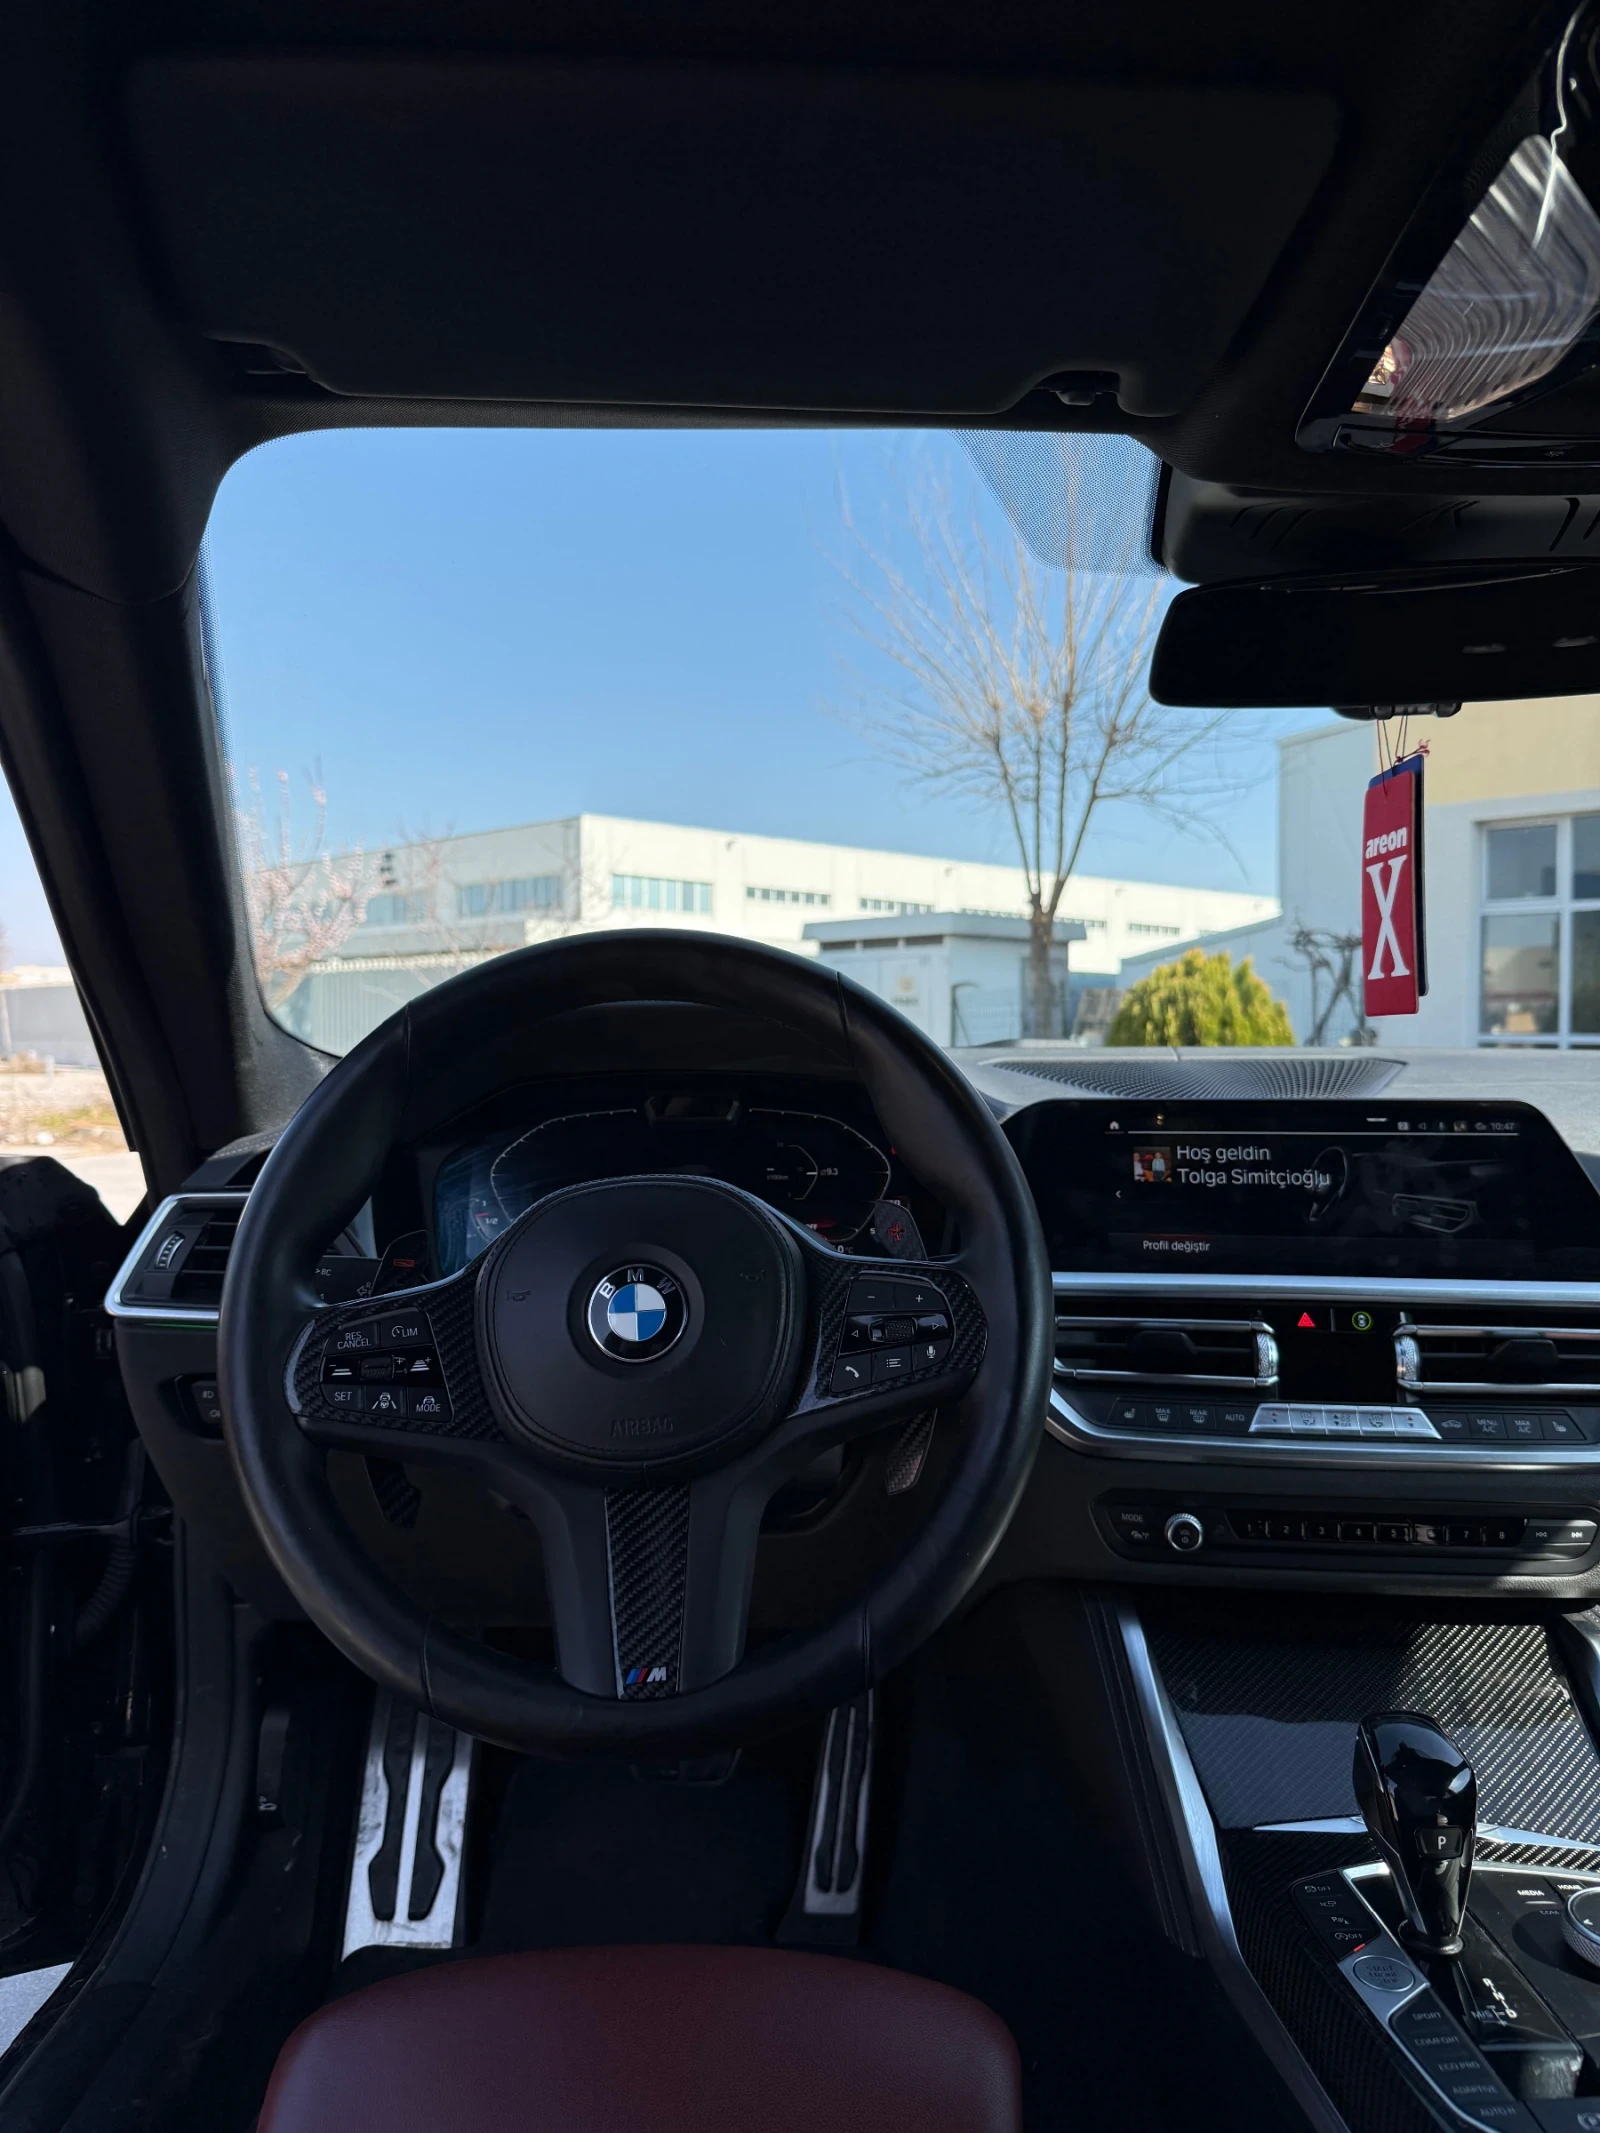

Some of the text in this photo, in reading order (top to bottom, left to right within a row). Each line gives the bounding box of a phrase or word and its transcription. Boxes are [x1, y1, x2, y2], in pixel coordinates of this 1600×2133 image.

[1365, 827, 1408, 859] areon
[1366, 854, 1410, 980] X
[1176, 1146, 1272, 1163] Hoş geldin
[1177, 1168, 1331, 1188] Tolga Simitçioğlu
[1143, 1240, 1211, 1252] Profil değiştir
[599, 1267, 676, 1300] BMW
[345, 1331, 362, 1341] RES
[402, 1327, 418, 1338] LIM
[337, 1338, 371, 1349] CANCEL
[334, 1391, 352, 1401] SET
[416, 1403, 441, 1413] MODE
[1155, 1407, 1171, 1415] MAX
[1190, 1408, 1207, 1416] REAR
[1224, 1413, 1245, 1422] AUTO
[1476, 1418, 1498, 1426] MENU
[611, 1417, 674, 1437] AIRBAG
[1121, 1513, 1144, 1522] MODE
[1283, 1525, 1290, 1535] 2
[1319, 1526, 1326, 1536] 3
[1355, 1527, 1363, 1536] 4
[1463, 1530, 1470, 1539] 7
[1437, 1836, 1447, 1850] P
[1412, 2011, 1442, 2021] SPORT
[1414, 2036, 1459, 2047] COMFORT
[1438, 2061, 1480, 2072] ECO PRO
[1452, 2085, 1498, 2095] ADAPTIVE
[1480, 2107, 1506, 2117] AUTO
